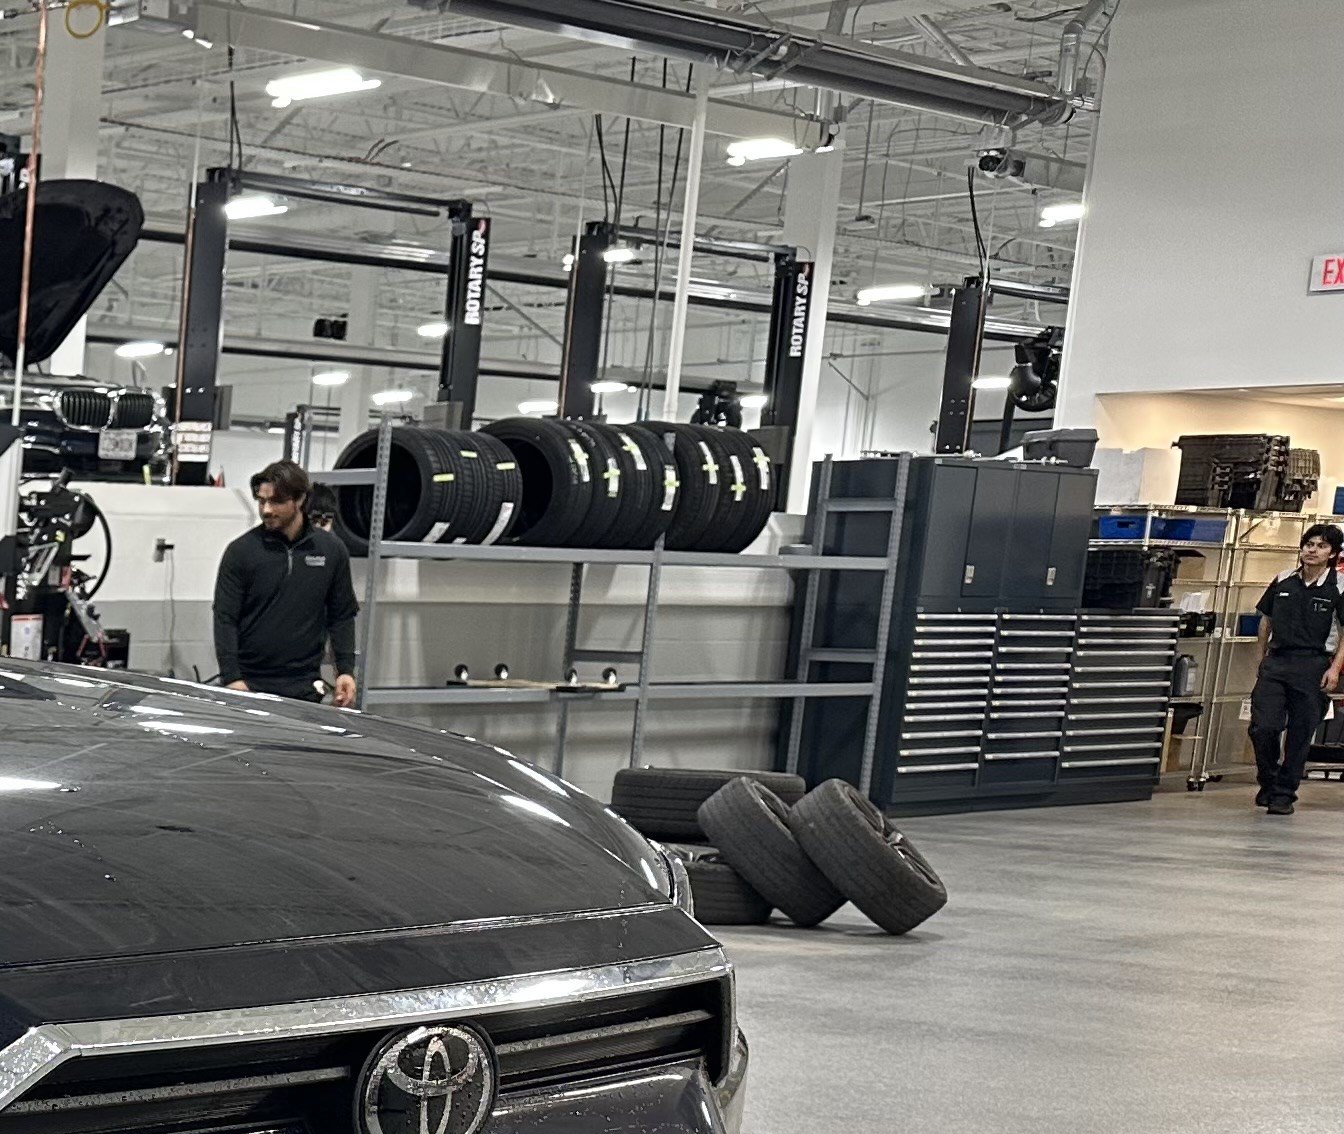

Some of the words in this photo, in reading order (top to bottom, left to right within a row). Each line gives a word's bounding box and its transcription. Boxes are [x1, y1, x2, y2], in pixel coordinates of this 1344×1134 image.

[471, 230, 486, 256] SP
[464, 255, 484, 325] ROTARY
[796, 272, 809, 296] SP
[789, 295, 807, 357] ROTARY
